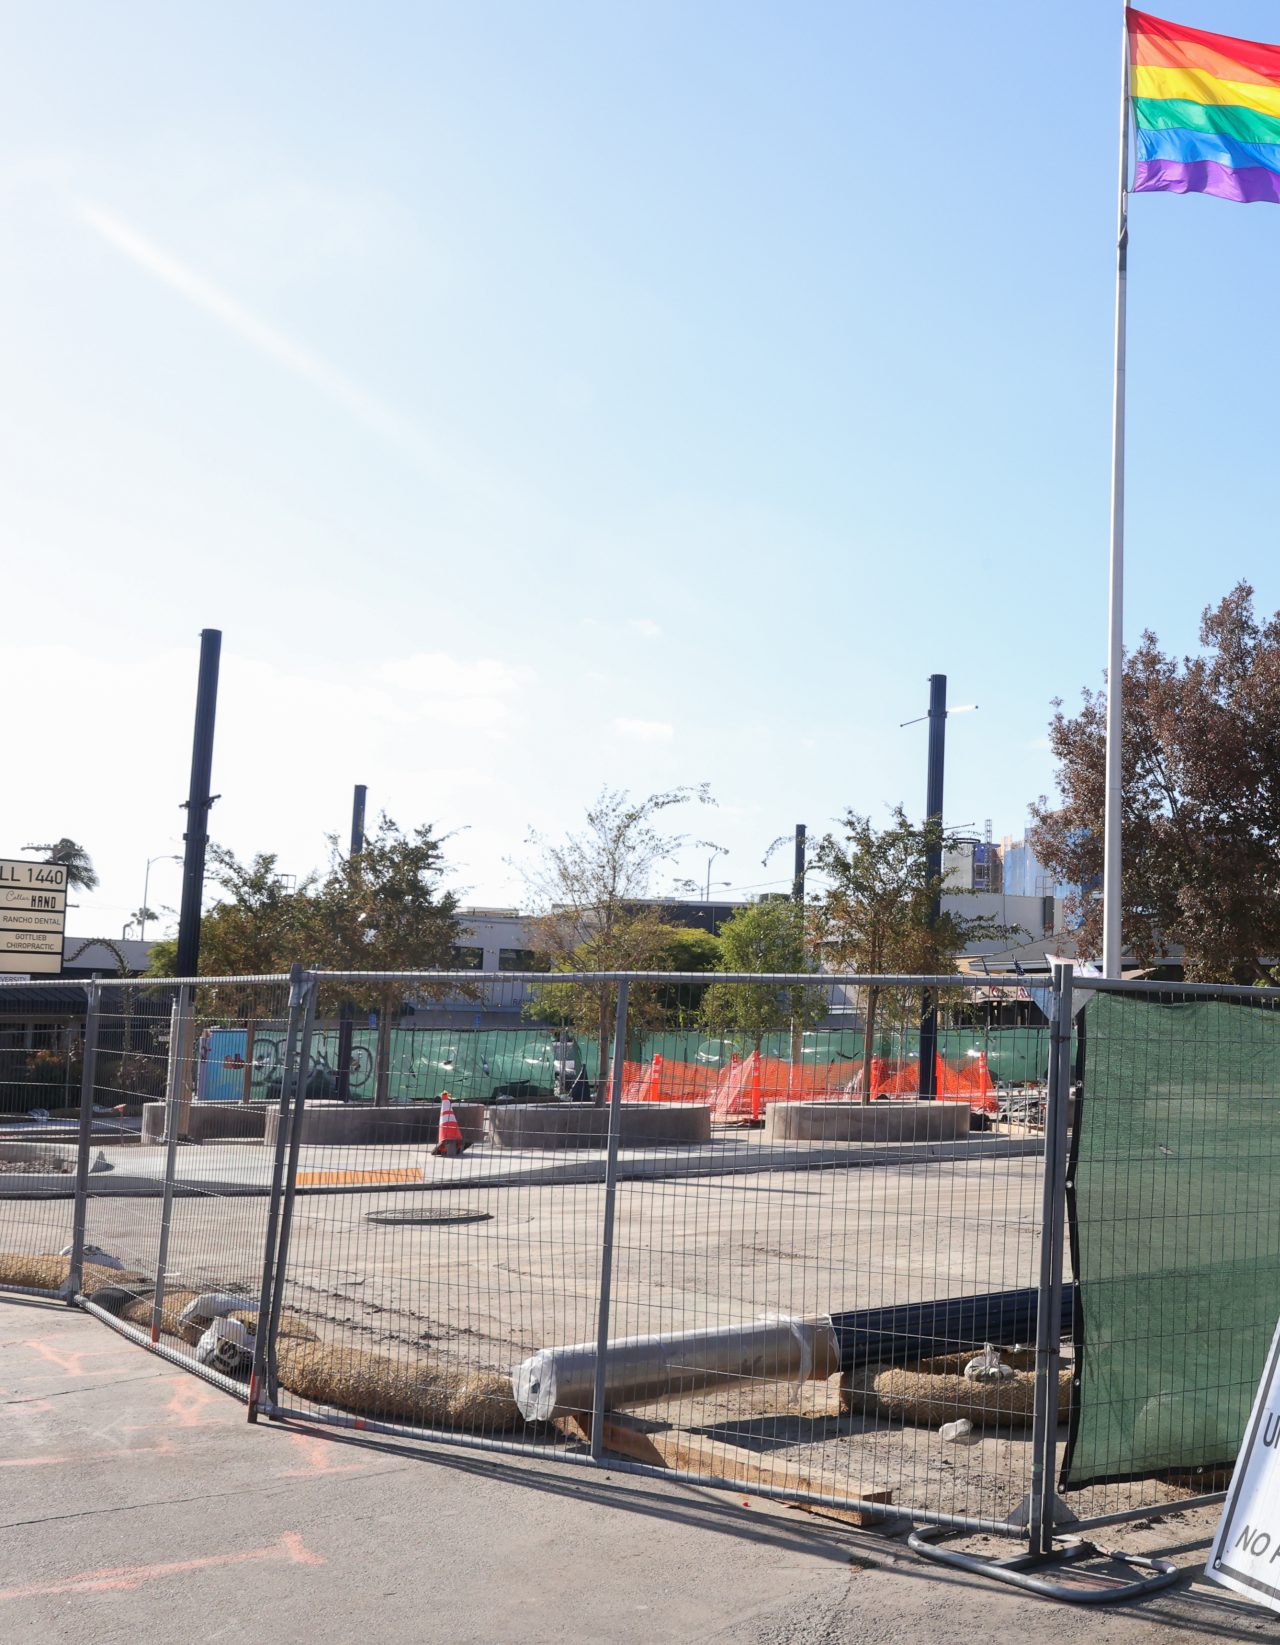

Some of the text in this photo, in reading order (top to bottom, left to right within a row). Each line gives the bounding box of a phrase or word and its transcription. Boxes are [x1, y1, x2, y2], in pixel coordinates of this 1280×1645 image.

[27, 867, 64, 885] 1440
[30, 895, 56, 909] HAND
[3, 915, 62, 926] RANCHO DENTAL
[15, 933, 47, 942] GOTTLIEB
[6, 941, 55, 951] CHIROPRACTIC
[1235, 1525, 1272, 1558] NO
